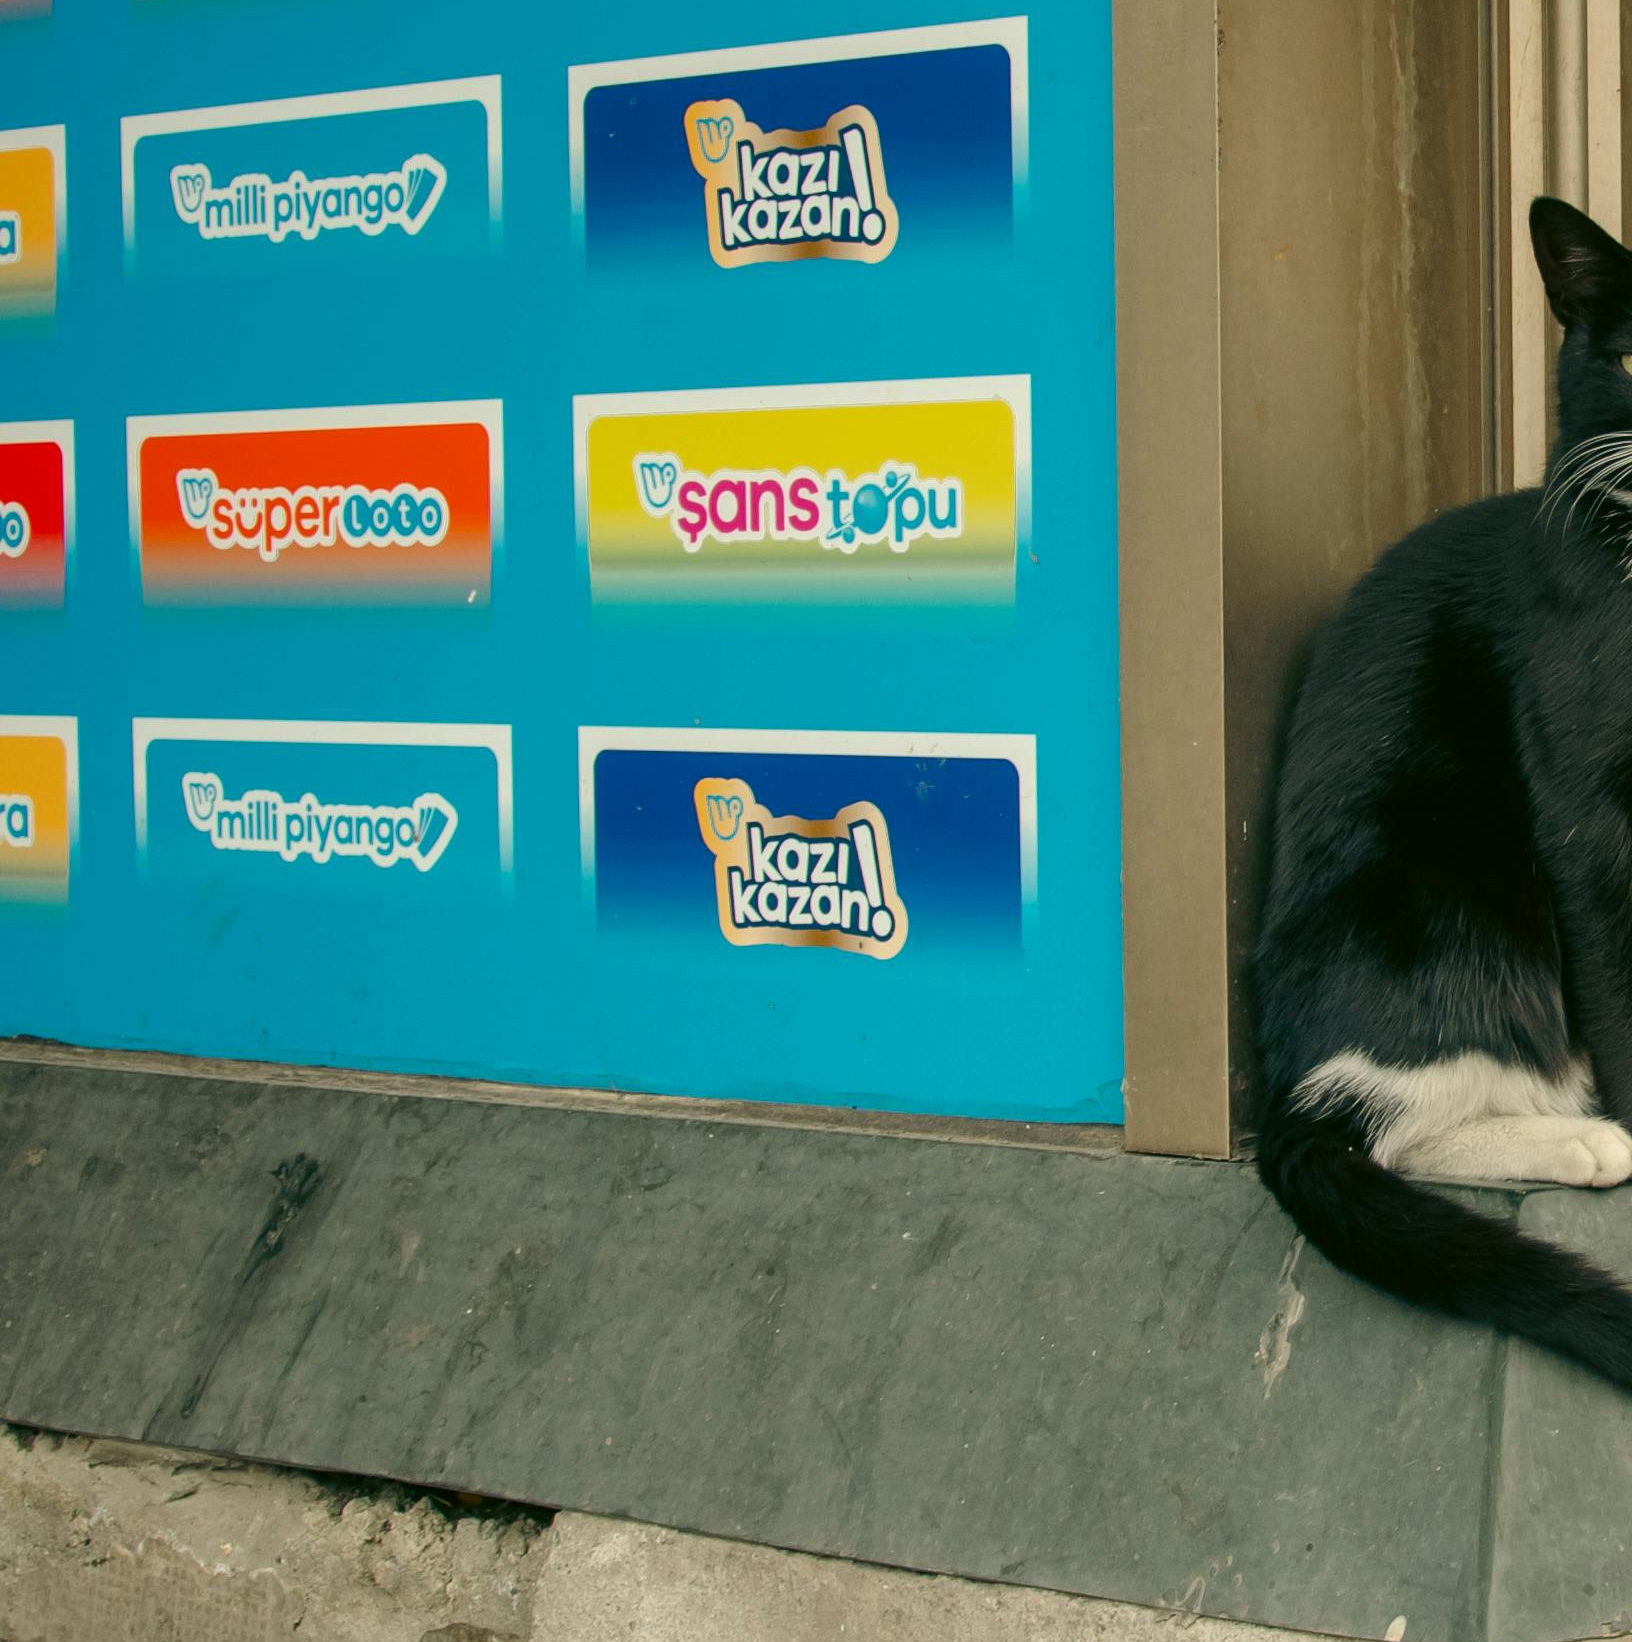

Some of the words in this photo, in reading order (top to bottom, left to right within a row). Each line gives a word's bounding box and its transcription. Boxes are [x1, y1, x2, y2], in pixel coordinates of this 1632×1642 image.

[740, 145, 840, 203] kazı
[205, 183, 266, 229] milli
[274, 182, 403, 232] piyango
[677, 477, 820, 544] şans
[826, 470, 957, 544] topu
[217, 801, 278, 842] milli
[286, 803, 415, 857] piyango
[750, 826, 850, 885] kazı
